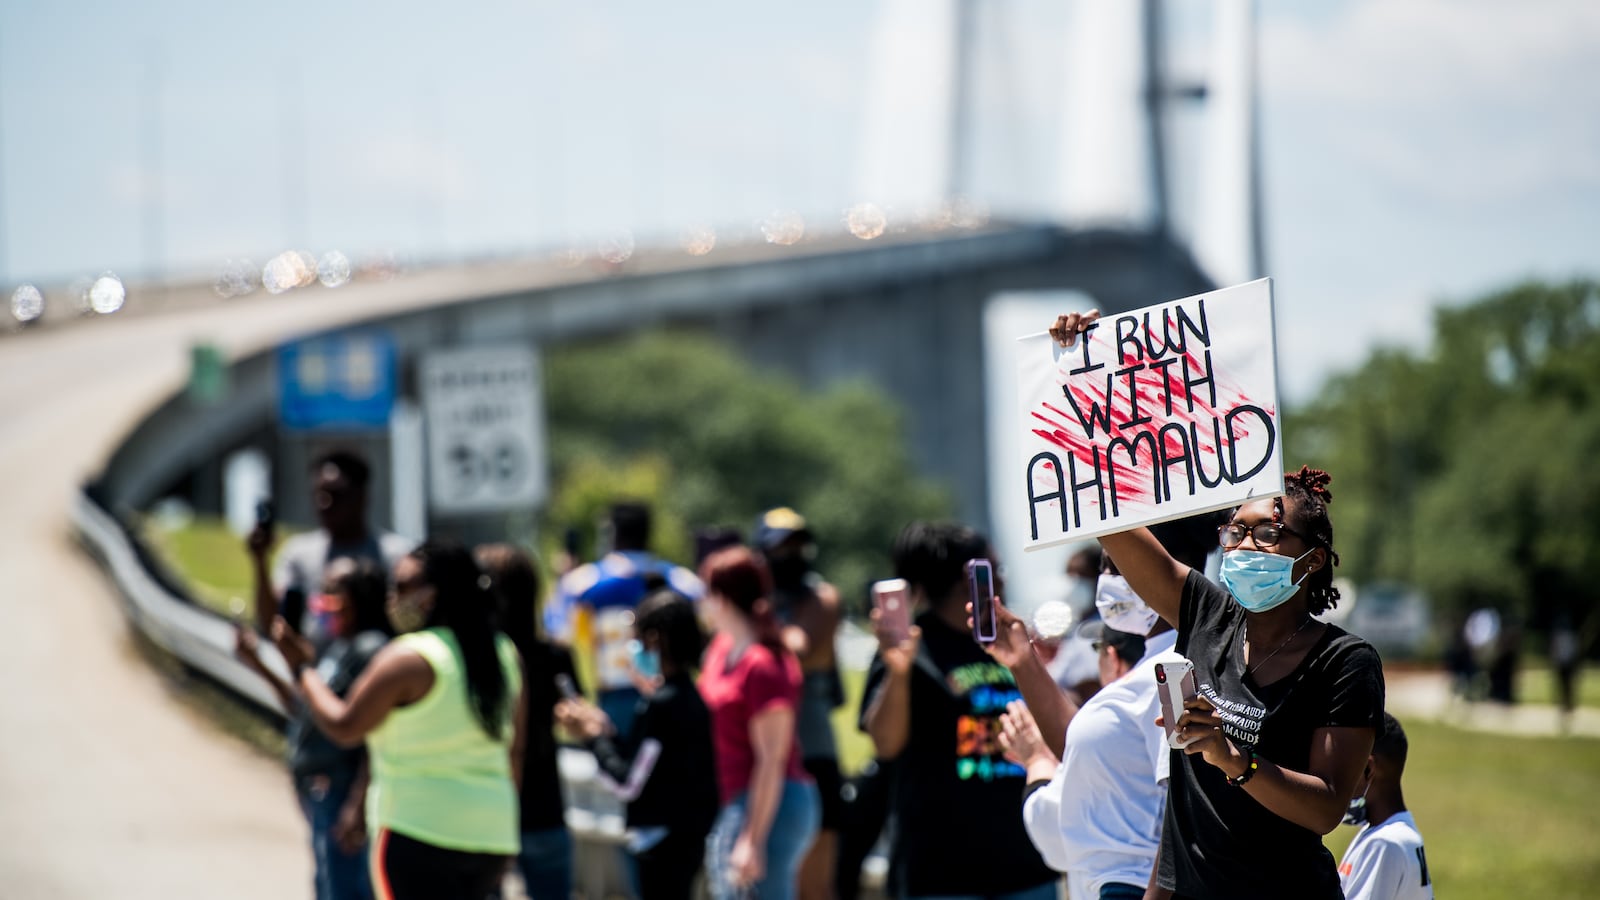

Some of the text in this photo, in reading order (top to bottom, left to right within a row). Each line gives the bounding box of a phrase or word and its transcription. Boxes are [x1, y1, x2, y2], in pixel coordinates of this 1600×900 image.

[1070, 299, 1210, 376] I RUN
[1062, 349, 1216, 439] WITH
[1027, 404, 1276, 540] AHMAUD
